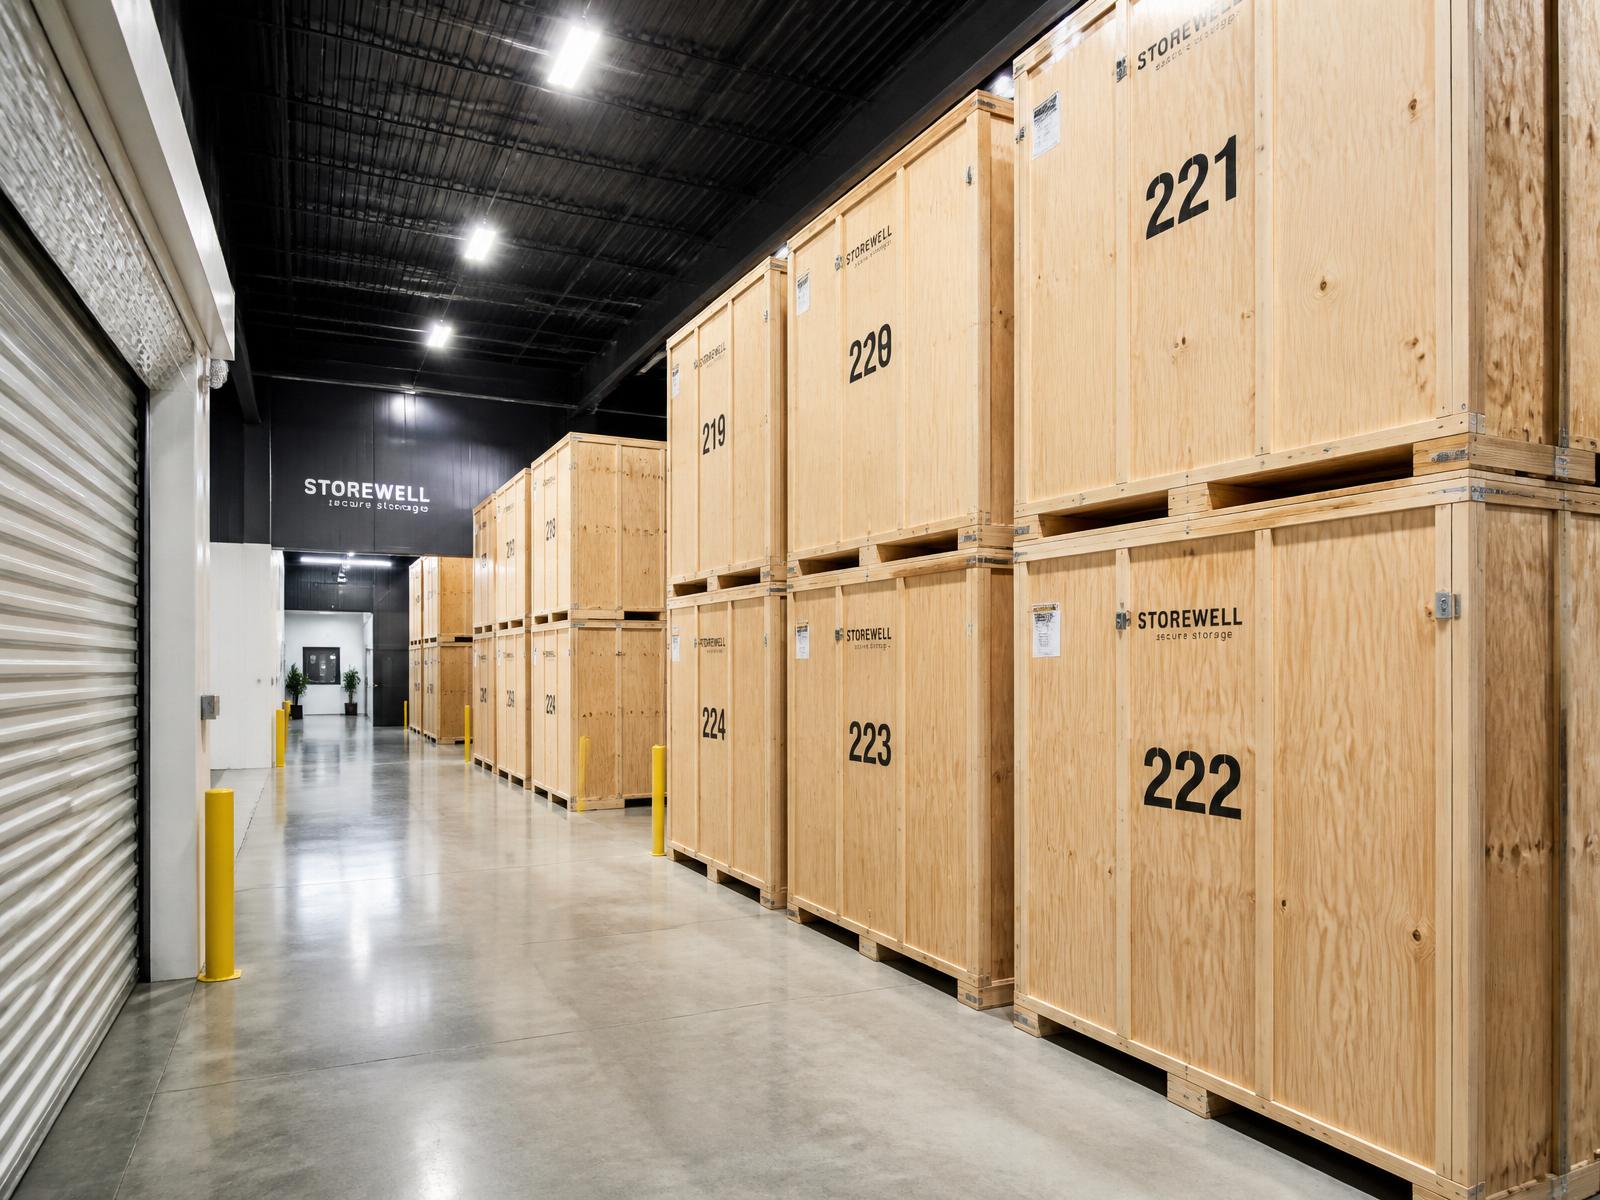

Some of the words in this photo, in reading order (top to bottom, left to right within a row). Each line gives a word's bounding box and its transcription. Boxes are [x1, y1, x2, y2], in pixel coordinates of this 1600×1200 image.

[1145, 134, 1237, 240] 221
[845, 225, 892, 266] STOREWELL
[849, 323, 892, 384] 220
[702, 413, 726, 456] 219
[304, 479, 430, 502] STOREWELL
[846, 627, 892, 642] STOREWELL
[1137, 607, 1243, 630] STOREWELL
[1156, 631, 1188, 641] secure
[1192, 630, 1233, 642] storage
[702, 707, 726, 741] 224
[849, 720, 892, 767] 223
[1143, 746, 1242, 821] 222
